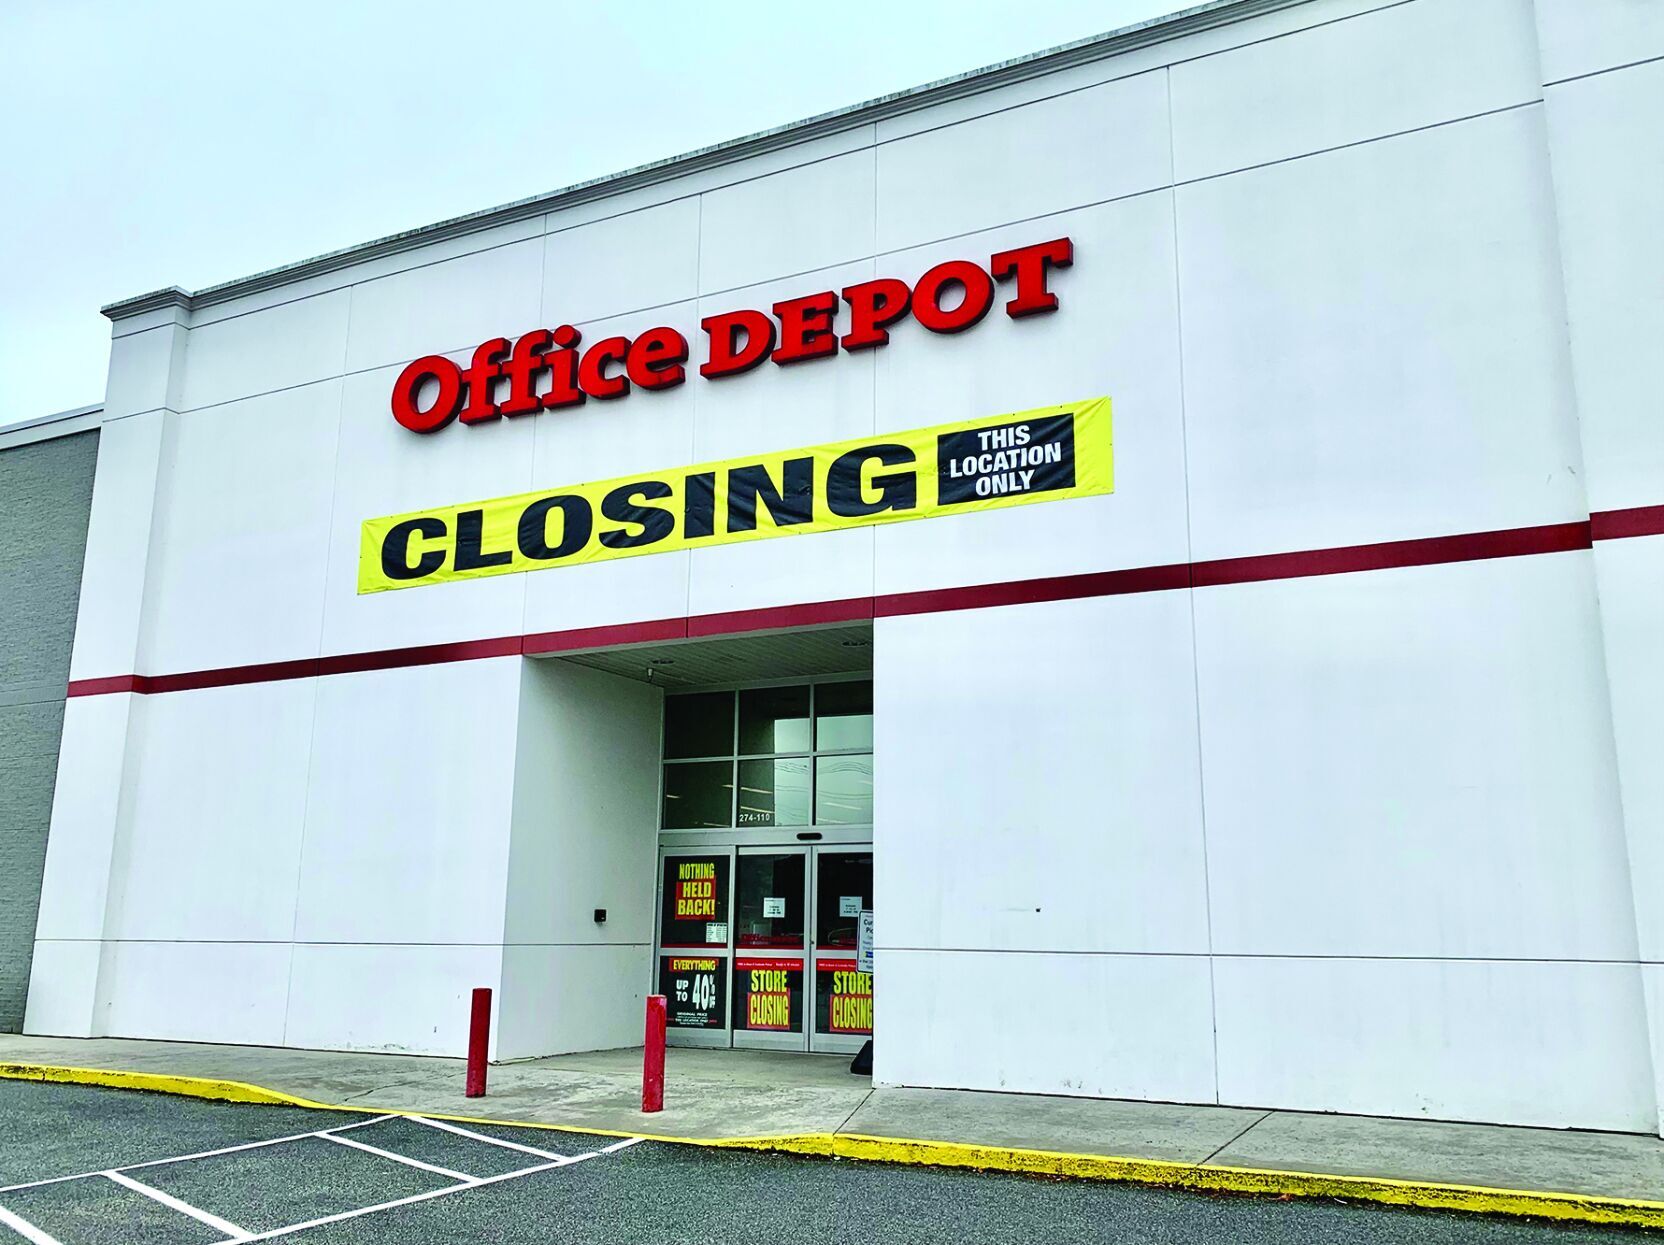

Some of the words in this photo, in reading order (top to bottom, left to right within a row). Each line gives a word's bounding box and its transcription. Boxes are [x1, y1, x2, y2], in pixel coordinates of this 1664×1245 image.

[391, 324, 688, 434] Office
[700, 237, 1073, 379] DEPOT
[978, 425, 1031, 451] THIS
[950, 442, 1061, 478] LOCATION
[975, 469, 1035, 496] ONLY
[380, 443, 917, 581] CLOSING
[739, 813, 770, 822] 274-110
[679, 863, 715, 880] NOTHING
[682, 882, 712, 898] HELD
[677, 899, 715, 915] BACK!
[673, 959, 716, 971] EVERYTHING
[676, 979, 689, 990] UP
[751, 970, 788, 992] STORE
[833, 971, 872, 994] STORE
[676, 991, 688, 1002] TO
[750, 995, 789, 1026] CLOSING
[832, 997, 873, 1029] CLOSING
